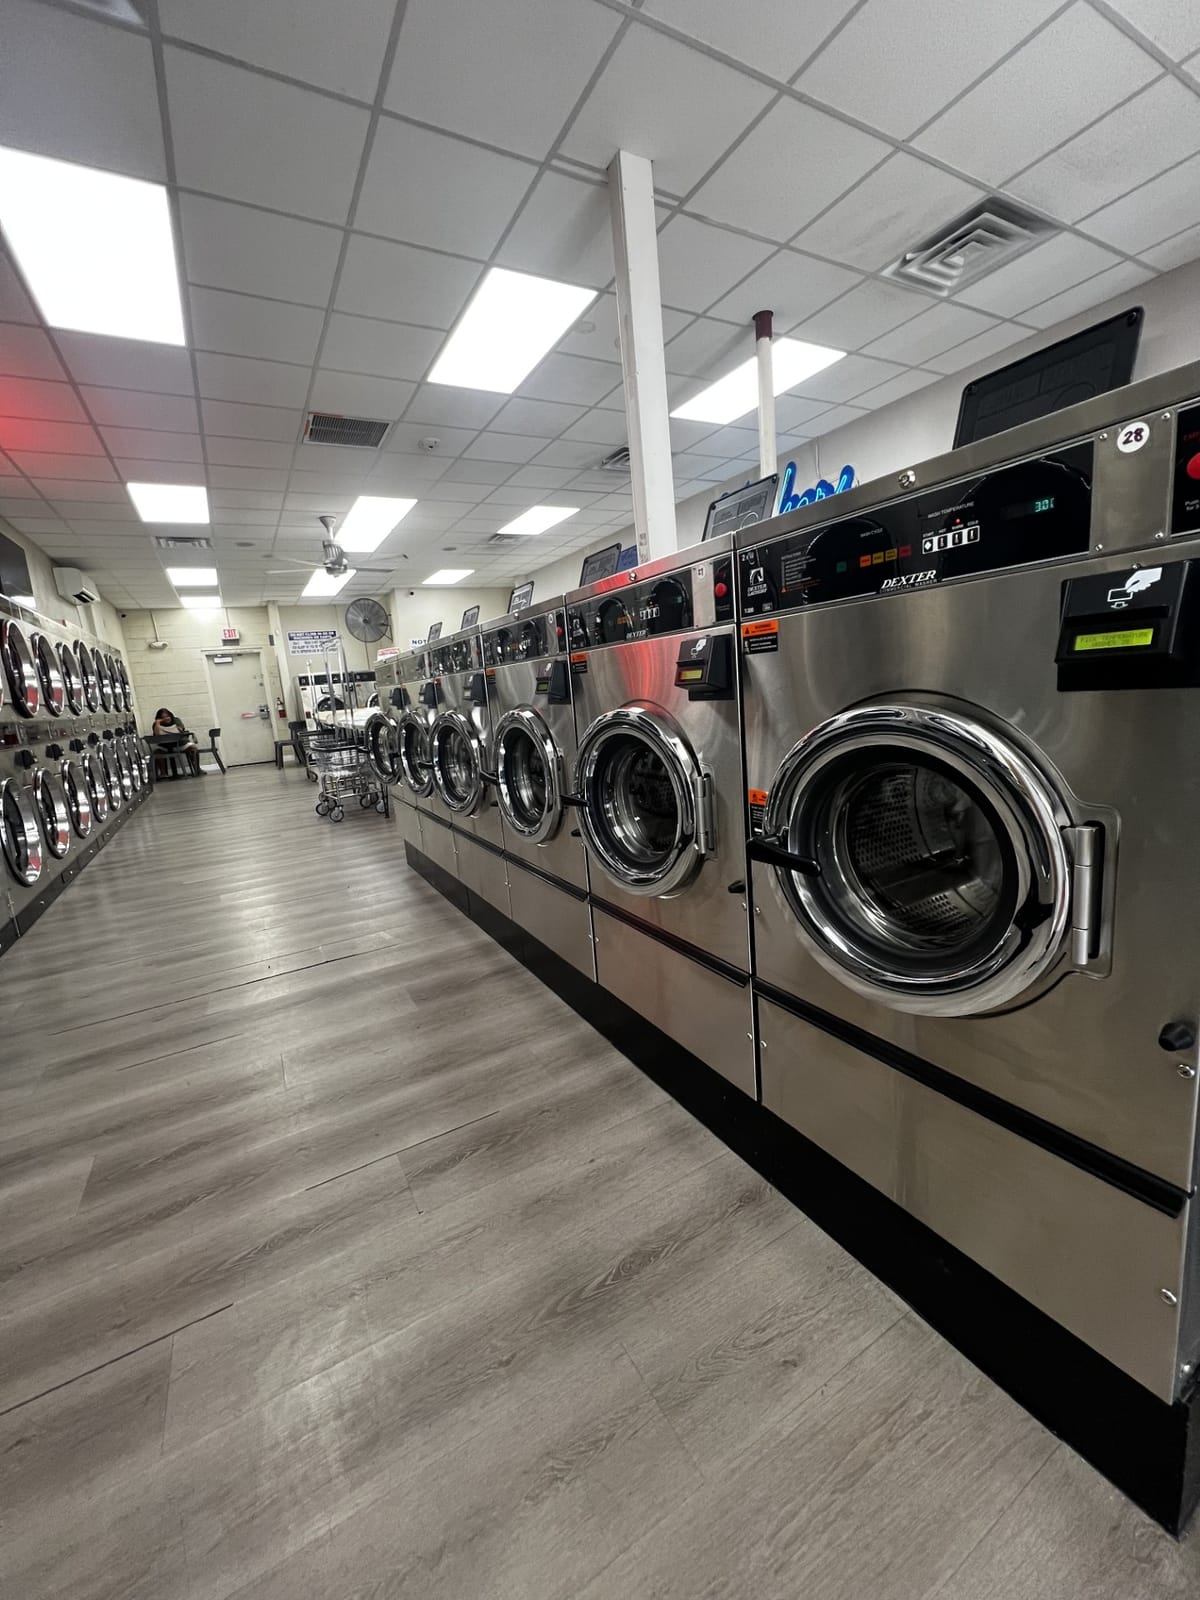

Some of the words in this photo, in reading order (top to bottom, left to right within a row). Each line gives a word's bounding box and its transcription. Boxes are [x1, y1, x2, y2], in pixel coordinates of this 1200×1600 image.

[1122, 428, 1145, 445] 28
[941, 501, 975, 514] TEMPERATURE
[881, 570, 937, 589] DEXTER
[747, 583, 767, 592] DEXTER
[223, 628, 237, 638] EXIT
